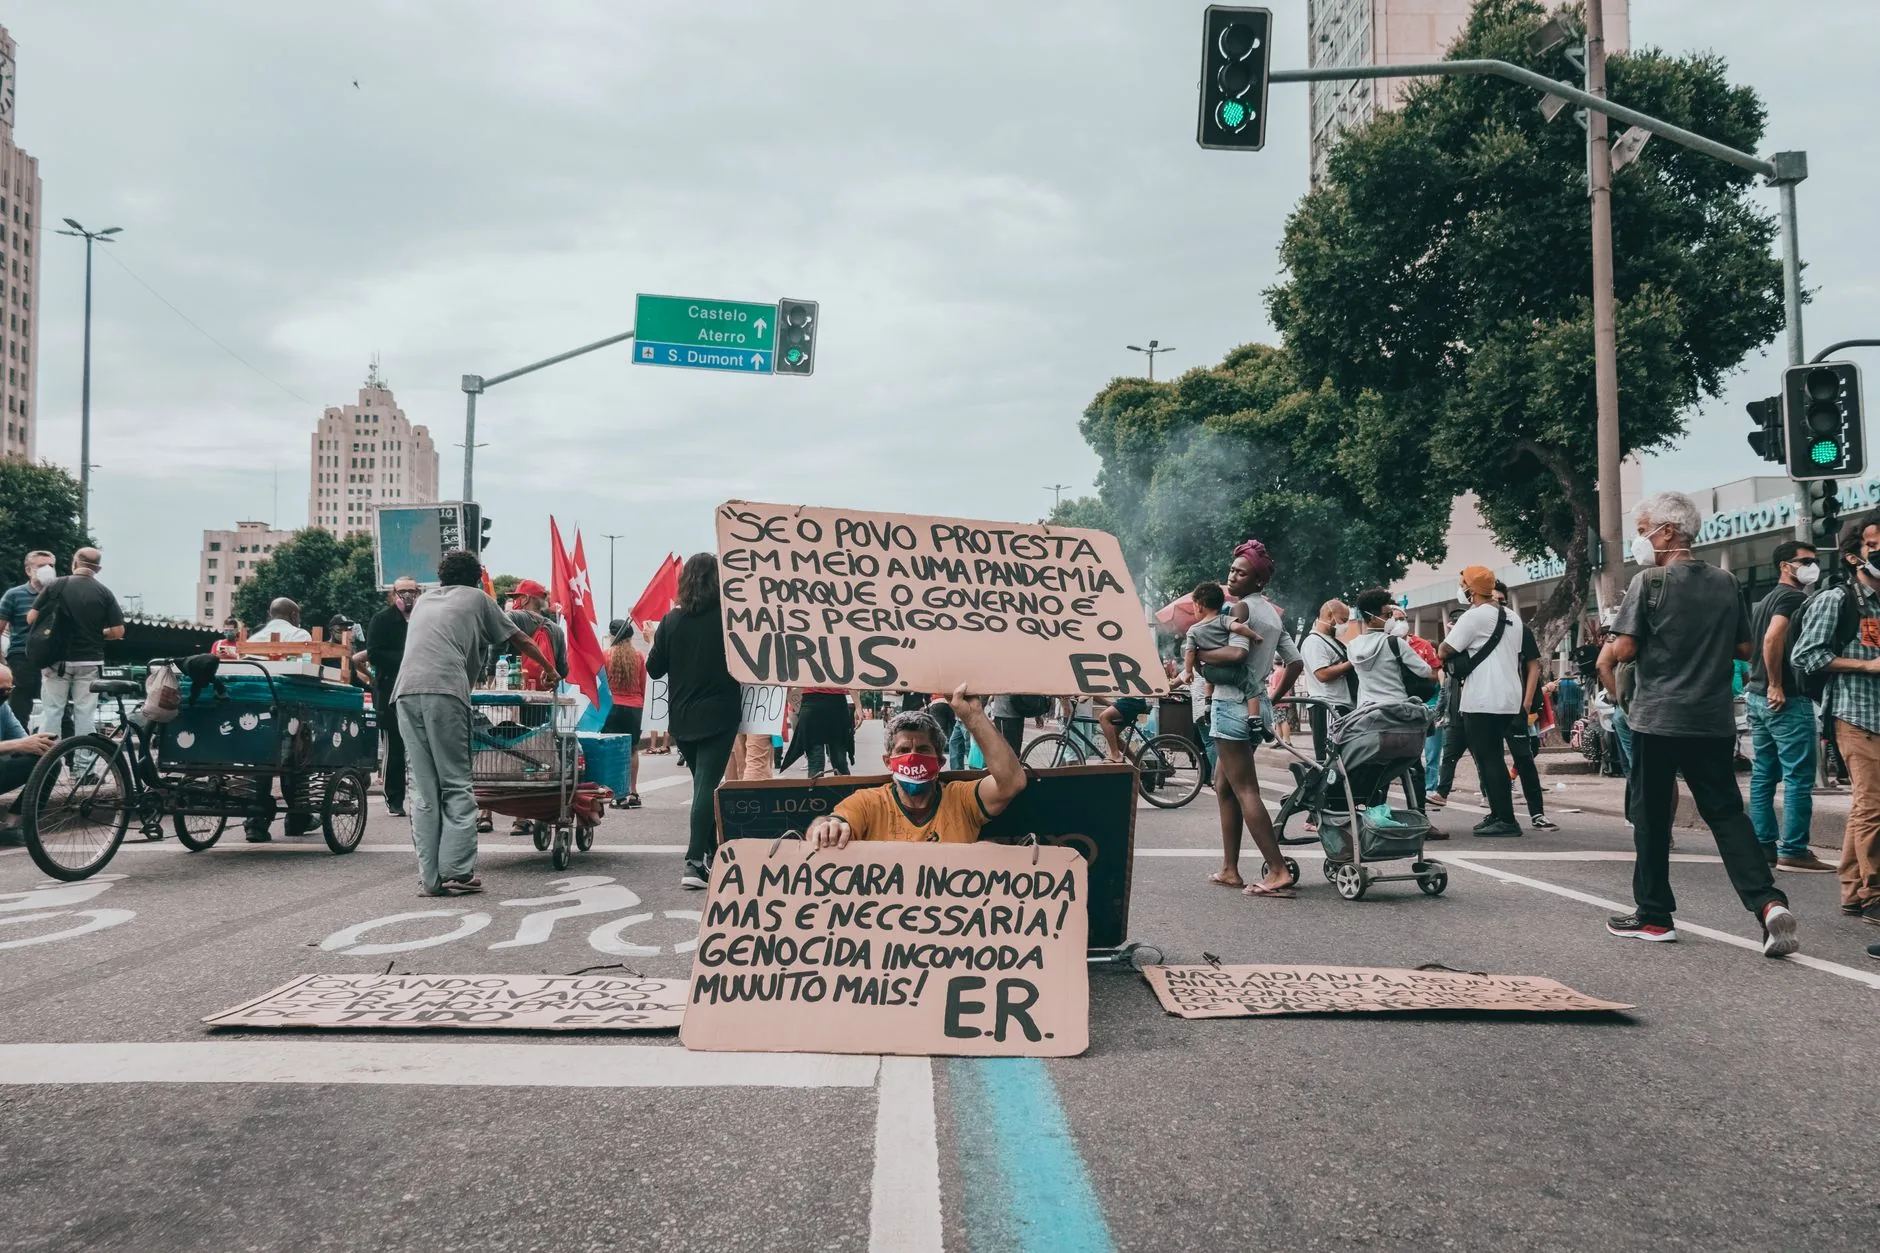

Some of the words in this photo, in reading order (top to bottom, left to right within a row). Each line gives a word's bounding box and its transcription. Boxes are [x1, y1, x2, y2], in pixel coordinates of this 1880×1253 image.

[688, 305, 747, 322] Castelo
[698, 328, 746, 343] Aterro
[668, 349, 682, 362] S.
[687, 350, 744, 367] Dumont
[1837, 480, 1880, 511] MAG
[797, 518, 822, 543] O
[835, 517, 917, 551] POVO
[930, 524, 1102, 564] PROTESTA
[722, 549, 781, 572] EM
[791, 549, 879, 577] MEIO
[887, 557, 910, 579] A
[910, 556, 968, 585] UMA
[974, 559, 1125, 594] PANDEMIA
[723, 572, 756, 603] É
[759, 577, 876, 608] PORQUE
[891, 584, 913, 606] O
[922, 586, 1064, 616] GOVERNO
[1071, 595, 1100, 617] É
[727, 605, 811, 633] MAIS
[822, 605, 1008, 634] PERIGOSO
[1016, 617, 1085, 642] QUE
[1096, 620, 1123, 642] O
[741, 685, 784, 722] ARO
[898, 764, 928, 776] FORA
[757, 851, 905, 898] MÁSCARA
[916, 864, 1076, 901] INCOMODA
[706, 899, 787, 932] MAS
[794, 898, 831, 931] É
[828, 899, 1069, 940] NECESSÁRIA!
[698, 931, 872, 971] GENOCIDA
[882, 942, 1044, 971] INCOMODA
[537, 978, 667, 992] TUDO
[832, 969, 930, 1007] MAIS!
[1168, 979, 1320, 990] MILHARES
[1330, 982, 1375, 990] DE
[1246, 970, 1391, 983] ADIANTA
[286, 990, 395, 1001] FOR
[406, 989, 651, 1003] PRIVADO
[1168, 987, 1363, 998] BOLSONARO
[241, 1009, 320, 1019] DE
[260, 999, 509, 1011] SEREMOS
[508, 1000, 686, 1012] PRIVADO
[943, 975, 1055, 1043] E.R.
